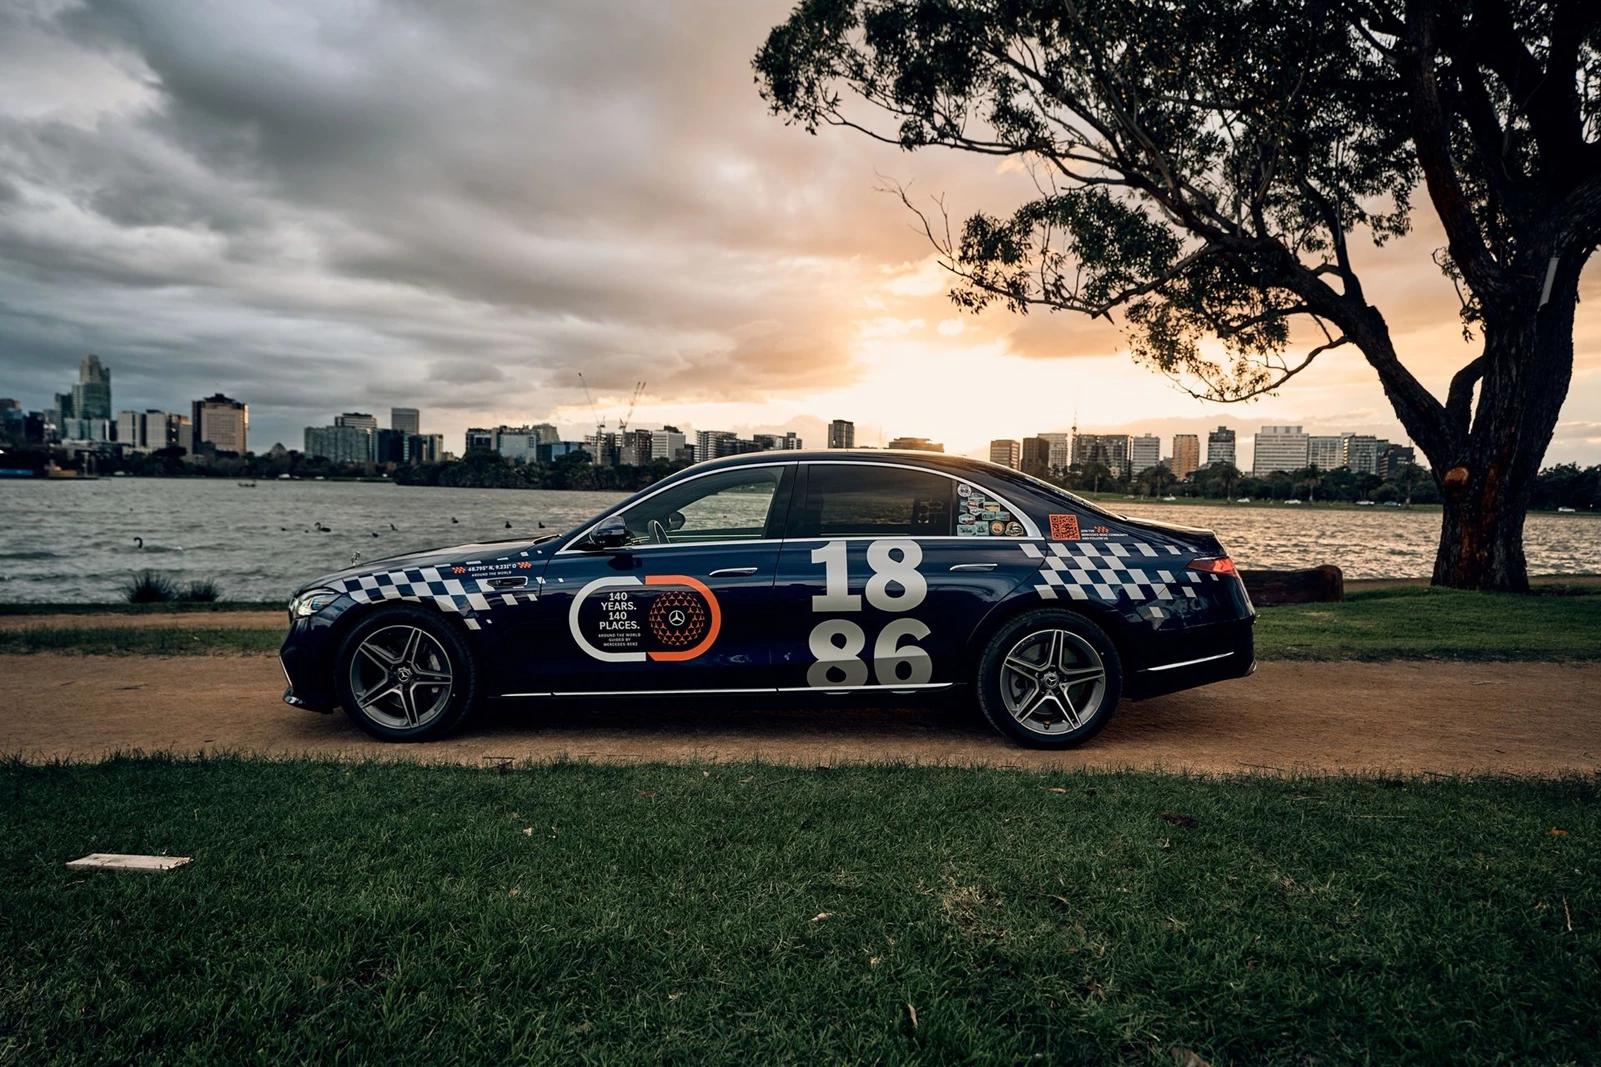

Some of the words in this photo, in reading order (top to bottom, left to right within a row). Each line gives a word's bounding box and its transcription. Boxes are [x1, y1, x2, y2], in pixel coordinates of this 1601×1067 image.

[811, 539, 928, 612] 18
[609, 591, 628, 601] 140
[600, 601, 637, 611] YEARS.
[609, 611, 627, 620] 140
[599, 620, 640, 630] PLACES.
[806, 617, 933, 694] 86
